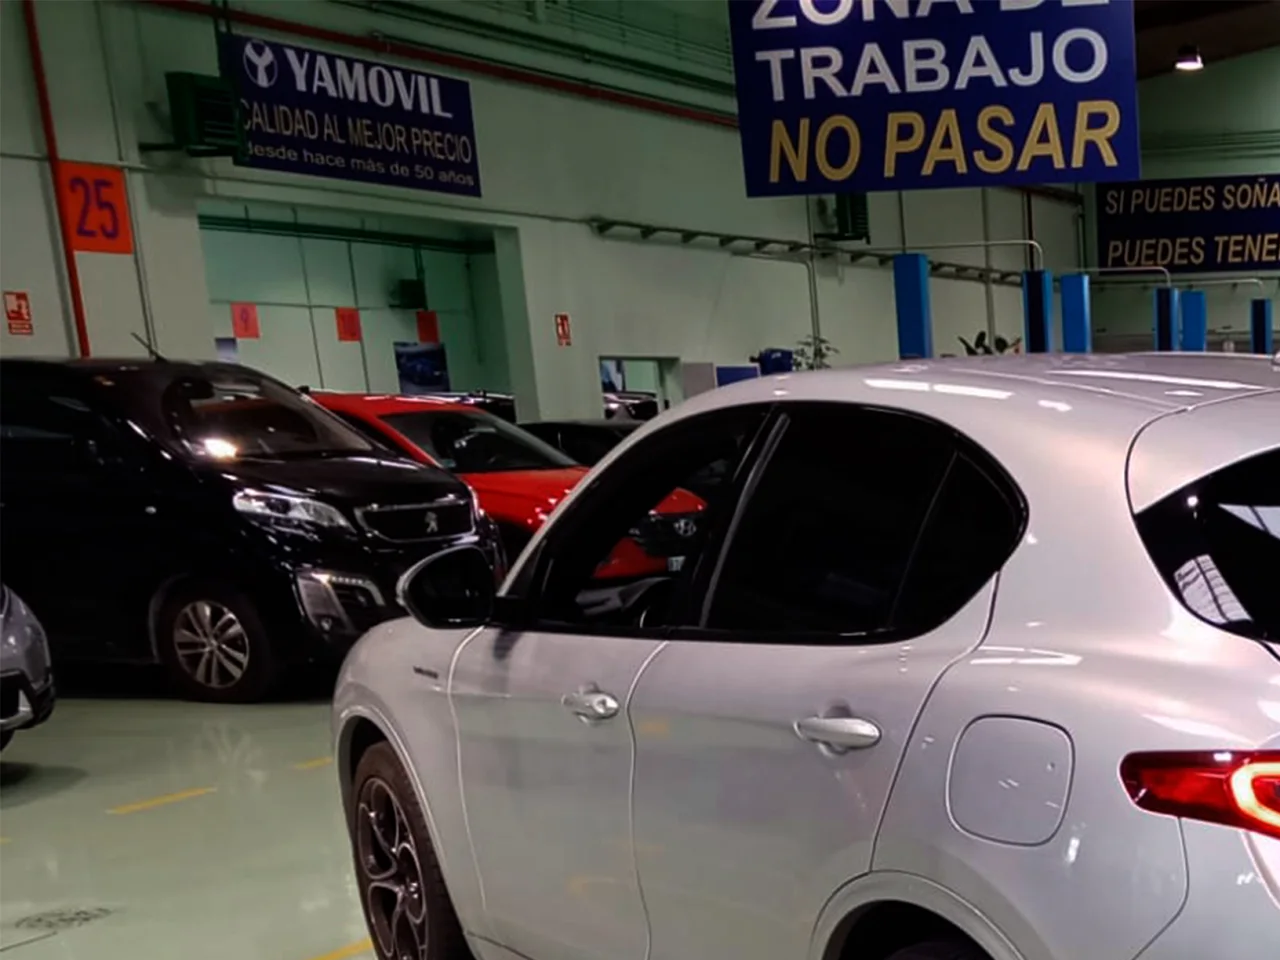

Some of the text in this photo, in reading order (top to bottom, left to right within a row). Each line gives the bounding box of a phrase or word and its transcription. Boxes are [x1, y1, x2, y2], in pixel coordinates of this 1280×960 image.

[283, 48, 453, 118] YAMOVIL
[755, 28, 1109, 102] TRABAJO
[323, 114, 346, 144] AL
[349, 117, 409, 154] MEJOR
[411, 128, 472, 164] PRECIO
[769, 99, 1122, 183] NO PASAR
[303, 150, 346, 168] hace
[390, 162, 410, 177] de
[414, 164, 434, 180] 50
[438, 168, 474, 187] años
[69, 177, 119, 240] 25
[1105, 189, 1125, 215] SI
[1131, 185, 1216, 214] PUEDES
[1107, 236, 1205, 267] PUEDES
